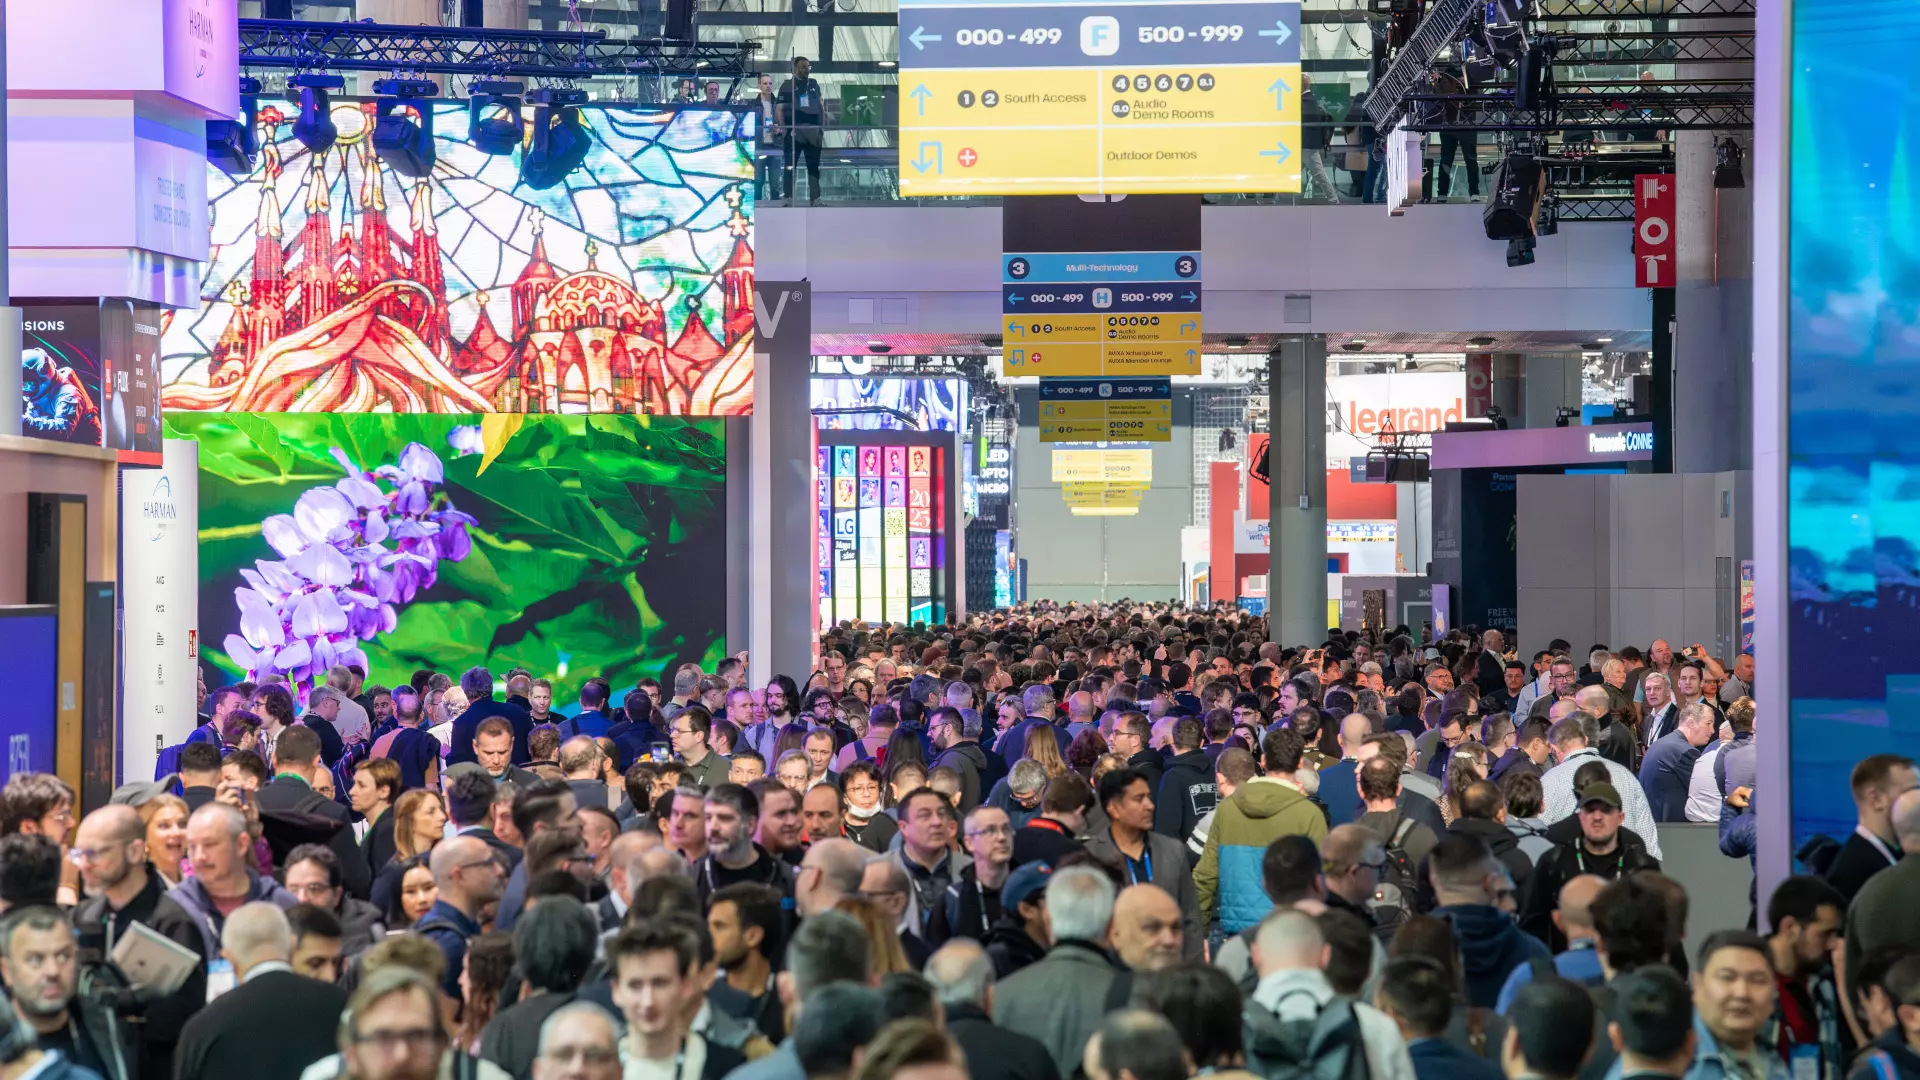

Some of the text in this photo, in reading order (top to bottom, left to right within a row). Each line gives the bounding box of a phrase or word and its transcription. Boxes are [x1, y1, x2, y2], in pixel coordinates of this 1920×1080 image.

[189, 9, 213, 45] HARMAN
[1091, 25, 1109, 47] F
[1004, 93, 1040, 104] South
[1042, 93, 1087, 103] Access
[1133, 99, 1167, 109] Audio
[1133, 109, 1214, 120] Demo Rooms
[1106, 150, 1198, 161] Outdoor Demos
[1066, 264, 1138, 272] Multi-Technology
[1096, 292, 1109, 304] H
[21, 321, 65, 331] SIONS
[1350, 397, 1463, 444] legrand
[143, 501, 177, 519] HARMAN
[836, 518, 854, 535] LG
[1249, 533, 1264, 541] with
